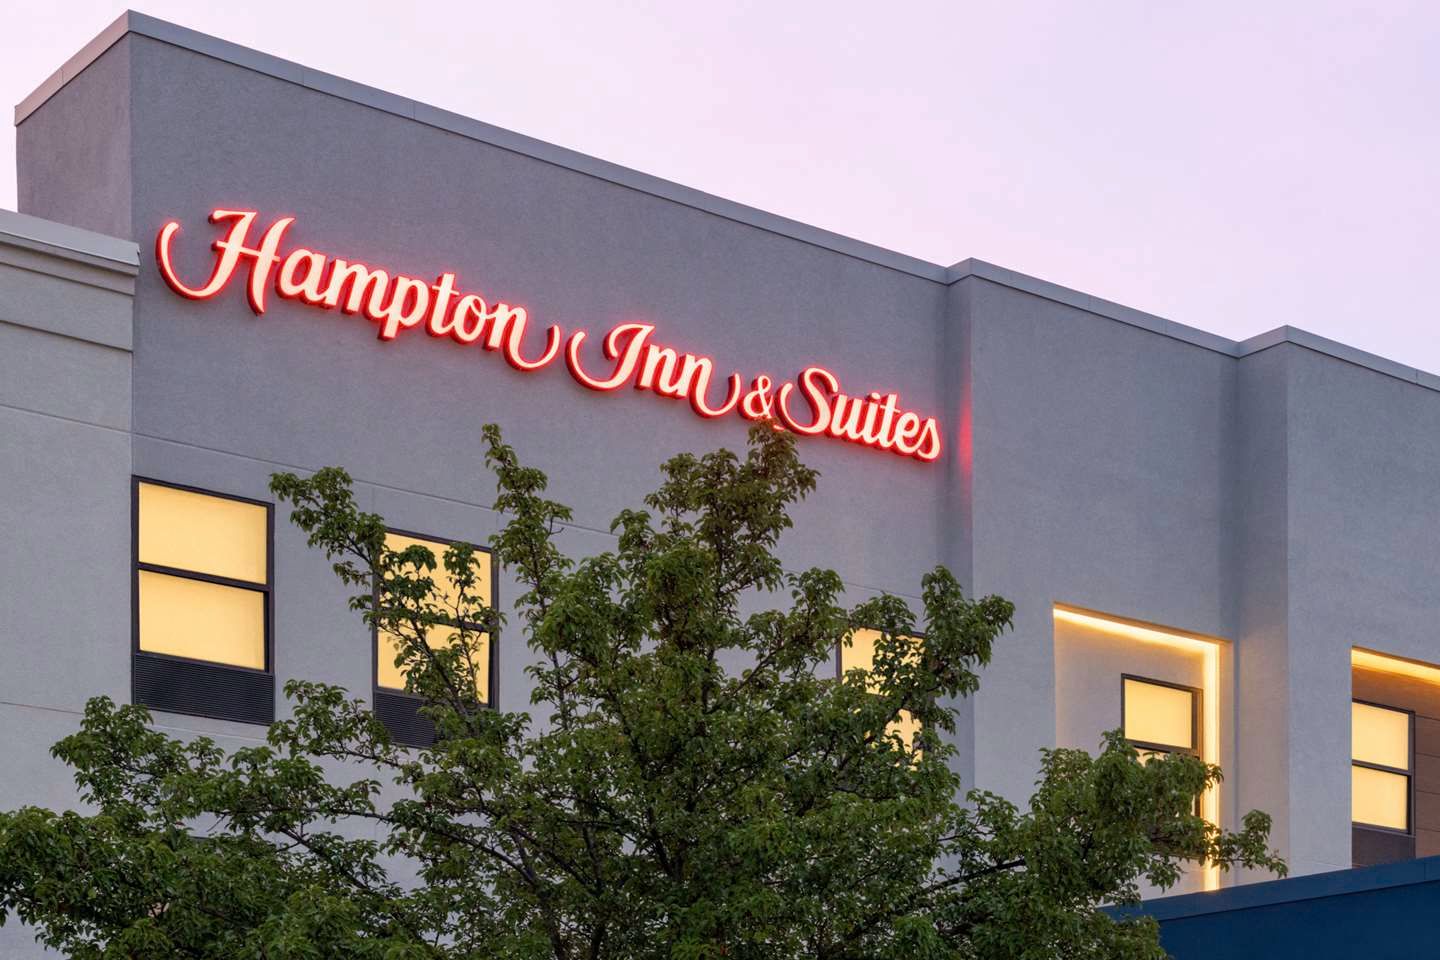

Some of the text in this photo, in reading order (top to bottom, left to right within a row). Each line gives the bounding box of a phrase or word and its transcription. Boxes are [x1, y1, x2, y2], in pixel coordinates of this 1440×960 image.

[156, 208, 942, 463] Hampton Inn & Suites
